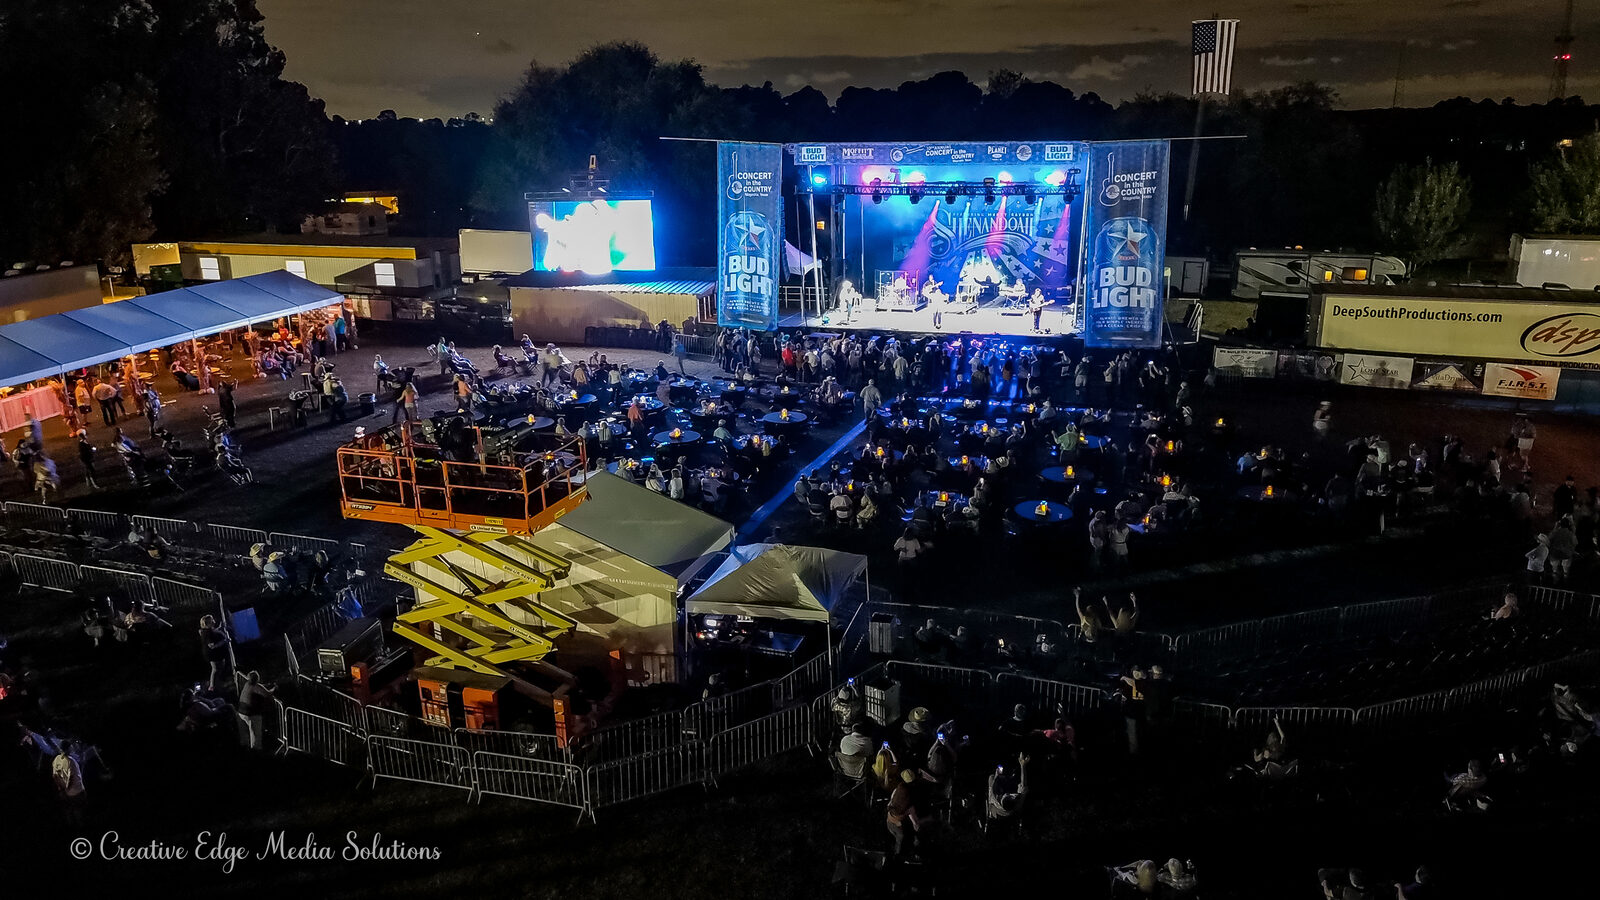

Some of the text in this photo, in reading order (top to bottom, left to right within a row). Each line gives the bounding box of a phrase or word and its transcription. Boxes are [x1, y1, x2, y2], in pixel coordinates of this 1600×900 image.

[988, 145, 1007, 154] PLANET
[1046, 152, 1072, 160] LIGHT
[737, 172, 772, 180] CONCERT
[1114, 171, 1157, 183] CONCERT
[1121, 187, 1156, 196] COUNTRY
[728, 255, 770, 276] BUD
[1100, 266, 1152, 287] BUD
[724, 274, 773, 298] LIGHT
[1093, 287, 1156, 308] LIGHT
[1332, 305, 1502, 323] DeepSouthProductions.com
[1535, 360, 1558, 368] SOUTH
[1498, 379, 1548, 389] F.I.R.S.T.
